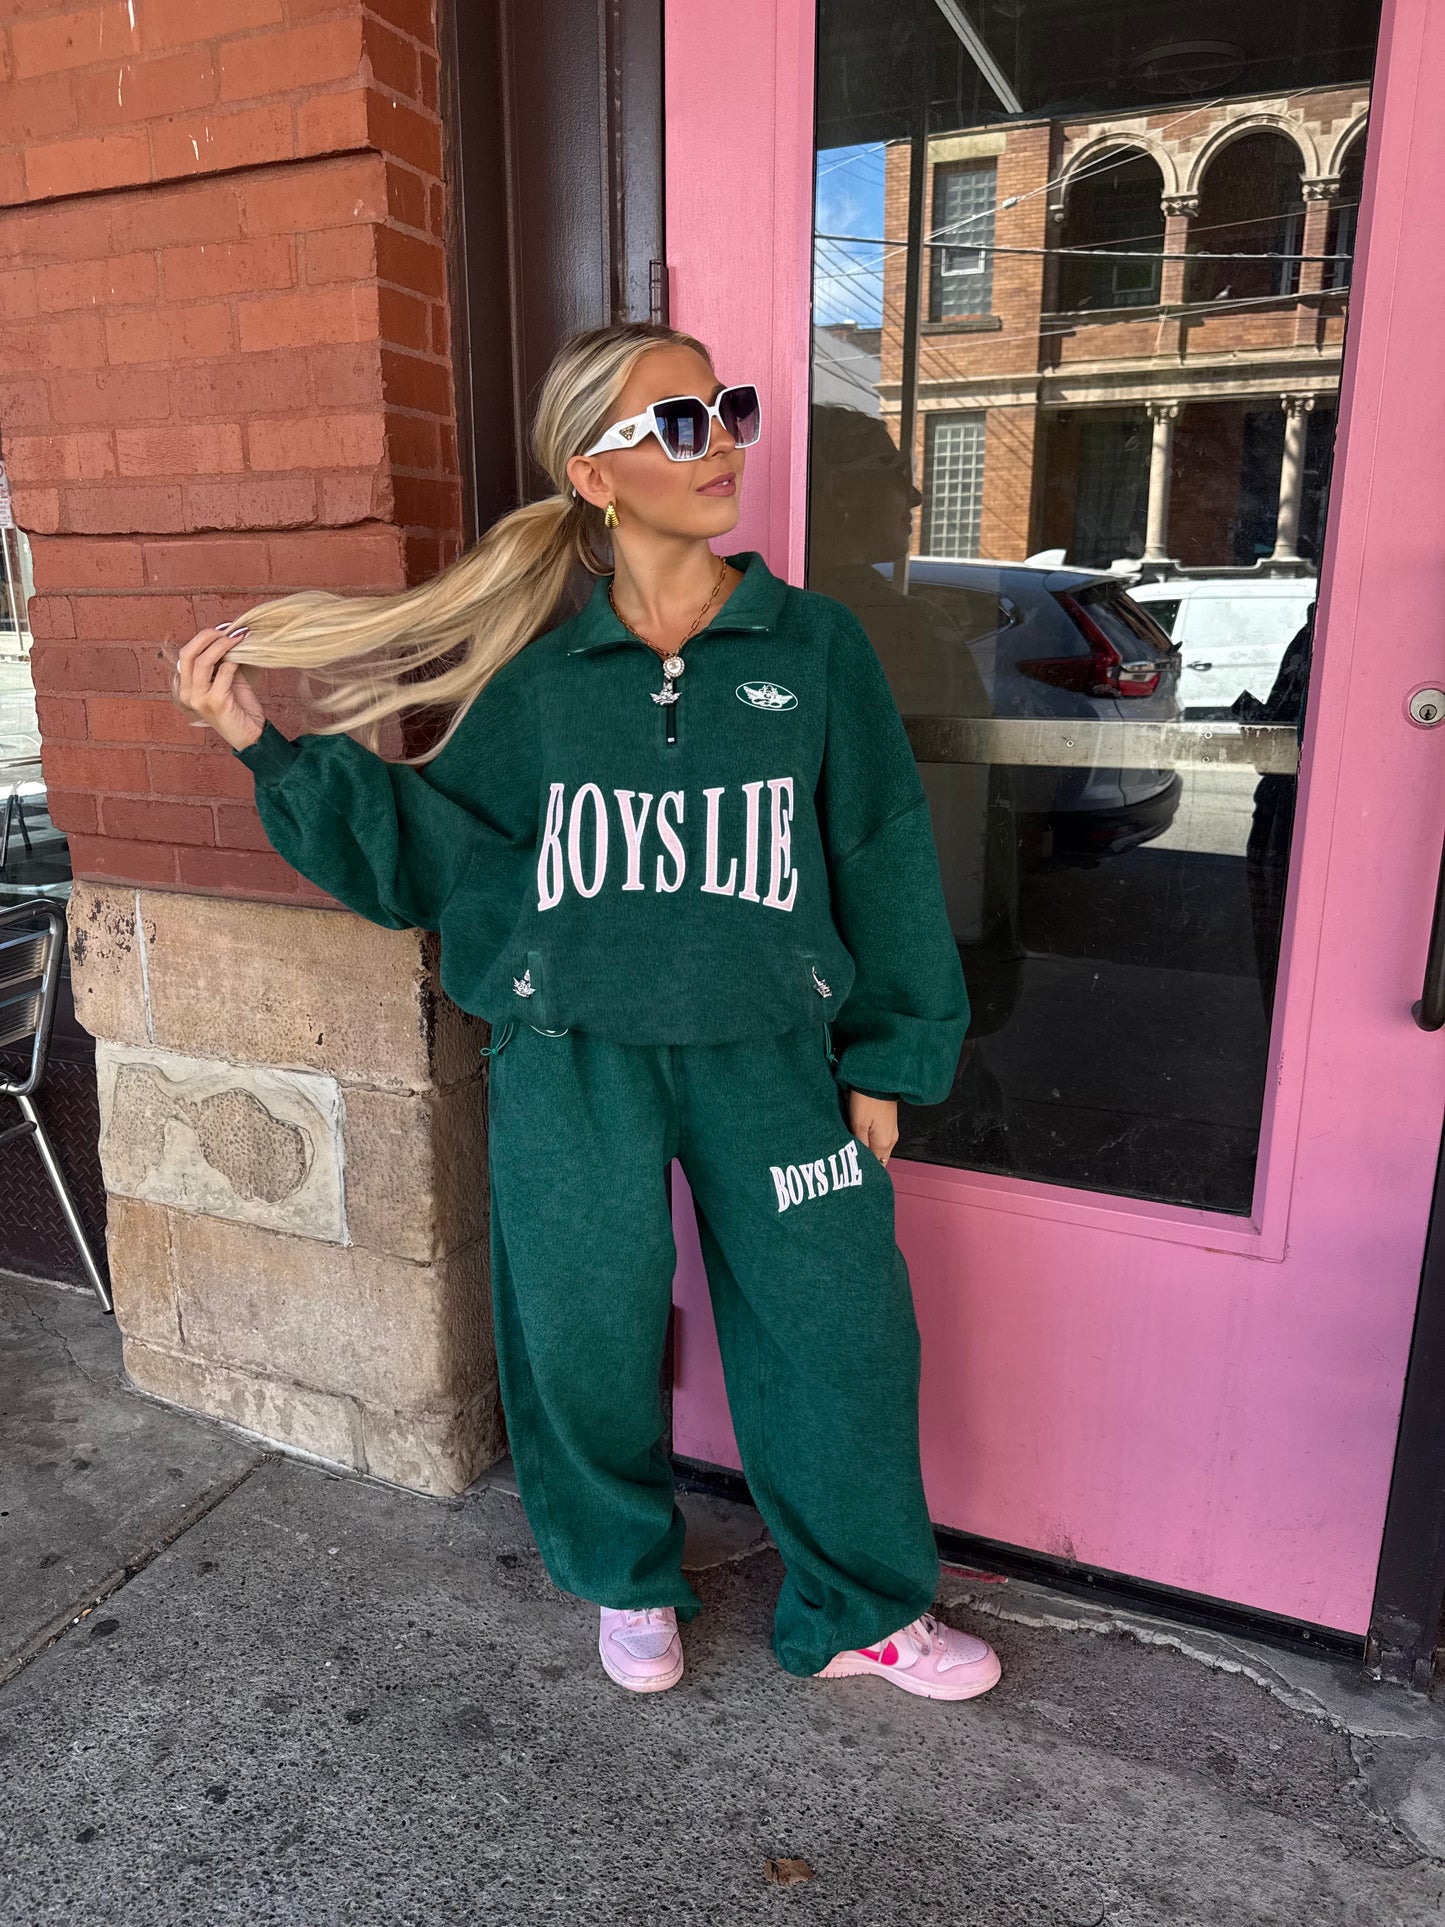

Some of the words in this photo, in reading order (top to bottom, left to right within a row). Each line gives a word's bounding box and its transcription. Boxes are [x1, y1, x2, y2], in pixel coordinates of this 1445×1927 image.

[537, 782, 686, 912] BOYS
[700, 777, 798, 912] LIE
[769, 1159, 829, 1213] BOYS
[828, 1139, 863, 1191] LIE
